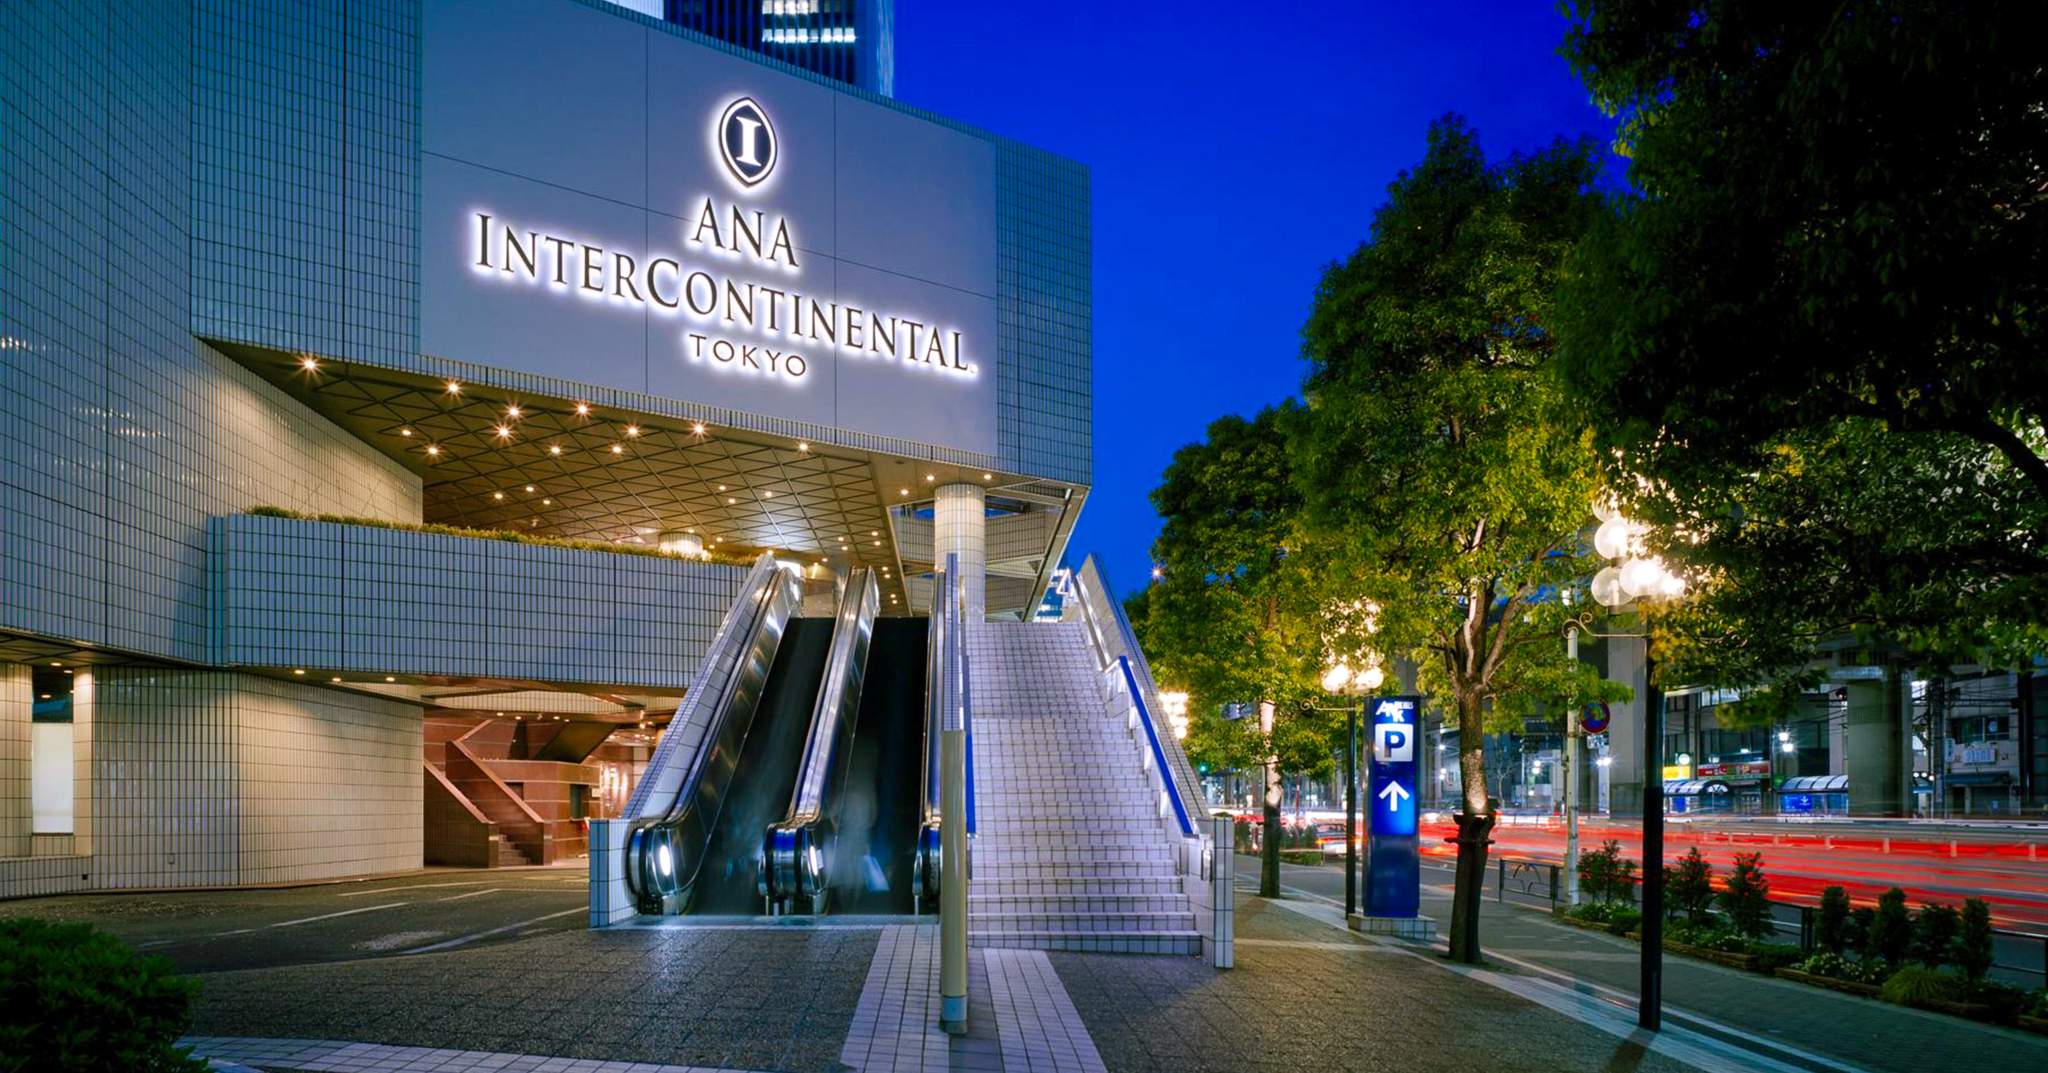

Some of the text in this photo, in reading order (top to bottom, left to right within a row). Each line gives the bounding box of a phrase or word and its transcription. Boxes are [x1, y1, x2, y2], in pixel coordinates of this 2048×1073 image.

[734, 115, 763, 168] I
[691, 197, 799, 267] ANA
[689, 334, 807, 377] TOKYO
[1384, 731, 1406, 758] P
